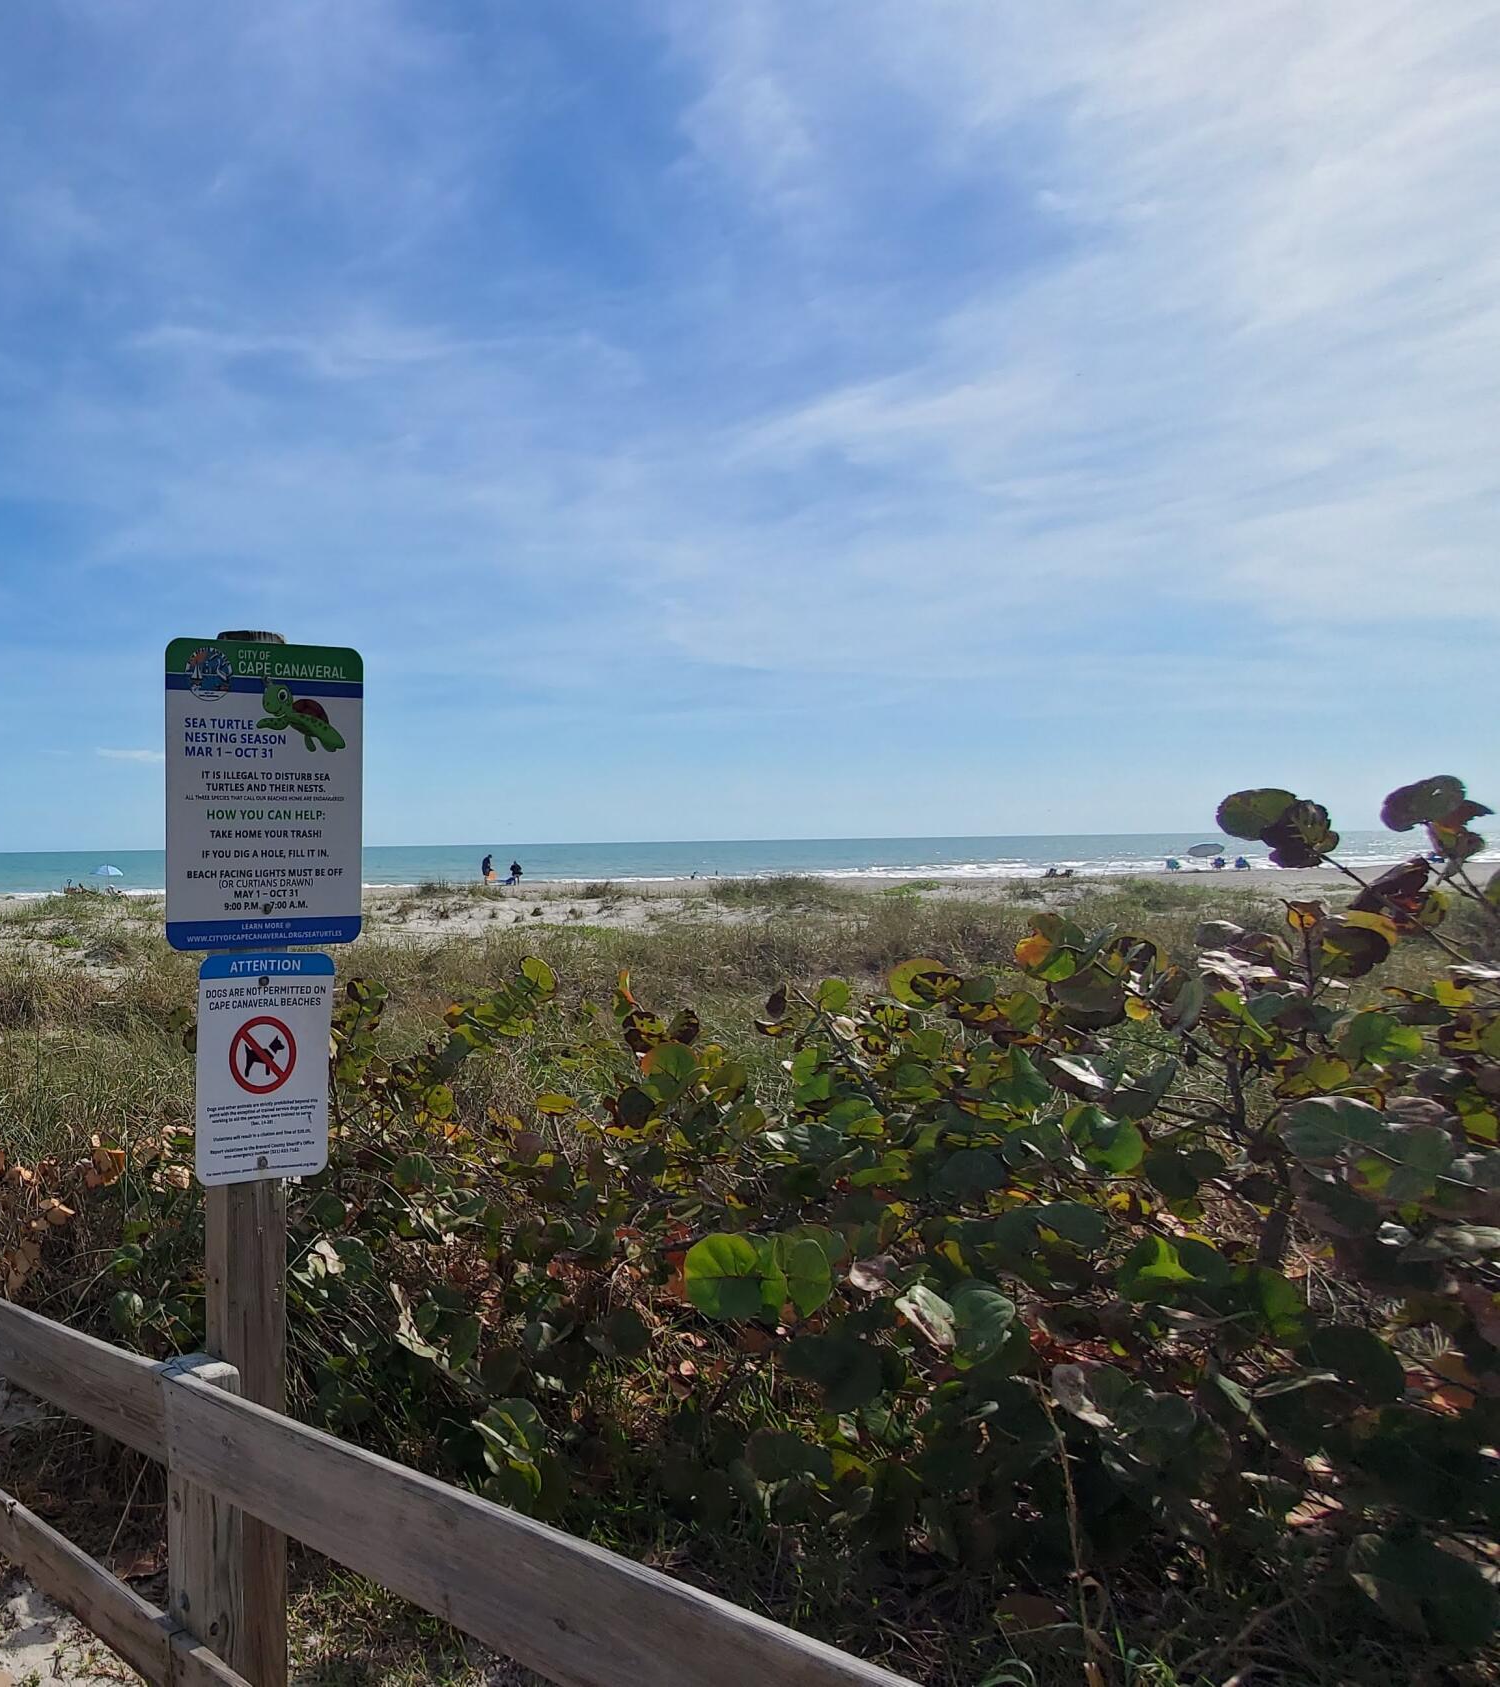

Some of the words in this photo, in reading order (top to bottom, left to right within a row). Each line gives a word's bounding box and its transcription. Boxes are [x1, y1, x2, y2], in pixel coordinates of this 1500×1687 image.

[238, 650, 257, 659] CITY
[259, 651, 270, 660] OF
[238, 661, 271, 675] CAPE
[275, 663, 346, 679] CANAVERAL
[185, 718, 206, 729] SEA
[210, 719, 253, 730] TURTLE
[185, 732, 237, 744] NESTING
[240, 734, 286, 744] SEASON
[185, 747, 212, 757] MAR
[235, 748, 259, 758] OCT
[261, 748, 273, 758] 31
[202, 771, 210, 779] IT
[213, 771, 221, 779] IS
[224, 771, 258, 780] ILLEGAL
[261, 772, 272, 780] TO
[274, 772, 312, 781] DISTURB
[314, 773, 330, 781] SEA
[206, 783, 245, 792] TURTLES
[247, 784, 267, 792] AND
[269, 784, 294, 792] THEIR
[297, 785, 326, 793] NESTS.
[206, 809, 236, 820] HOW
[240, 809, 264, 820] YOU
[267, 809, 292, 820] CAN
[295, 810, 325, 820] HELP:
[210, 830, 232, 839] TAKE
[235, 830, 262, 839] HOME
[264, 830, 288, 839] YOUR
[291, 830, 322, 839] TRASH!
[201, 850, 210, 858] IF
[212, 850, 231, 858] YOU
[234, 850, 250, 858] DIG
[252, 850, 259, 858] A
[261, 849, 286, 859] HOLE,
[288, 849, 305, 858] FILL
[307, 849, 316, 857] IT
[317, 849, 329, 858] IN.
[187, 870, 217, 879] BEACH
[220, 870, 253, 878] FACING
[255, 869, 286, 878] LIGHTS
[288, 869, 313, 877] MUST
[315, 868, 326, 877] BE
[327, 868, 343, 876] OFF
[219, 879, 234, 889] (OR
[280, 878, 314, 887] DRAWN)
[234, 890, 253, 899] MAY
[270, 889, 289, 898] OCT
[289, 889, 299, 897] 31
[224, 902, 242, 911] 9:00
[244, 901, 261, 910] P.M.
[270, 901, 287, 910] 7:00
[289, 900, 308, 909] A.M.
[230, 959, 301, 973] ATTENTION
[206, 988, 227, 999] DOGS
[229, 988, 245, 997] ARE
[246, 987, 261, 996] NOT
[263, 986, 311, 995] PERMITTED
[314, 986, 326, 994] ON
[209, 1001, 230, 1011] CAPE
[232, 998, 279, 1009] CANAVERAL
[281, 997, 321, 1007] BEACHES
